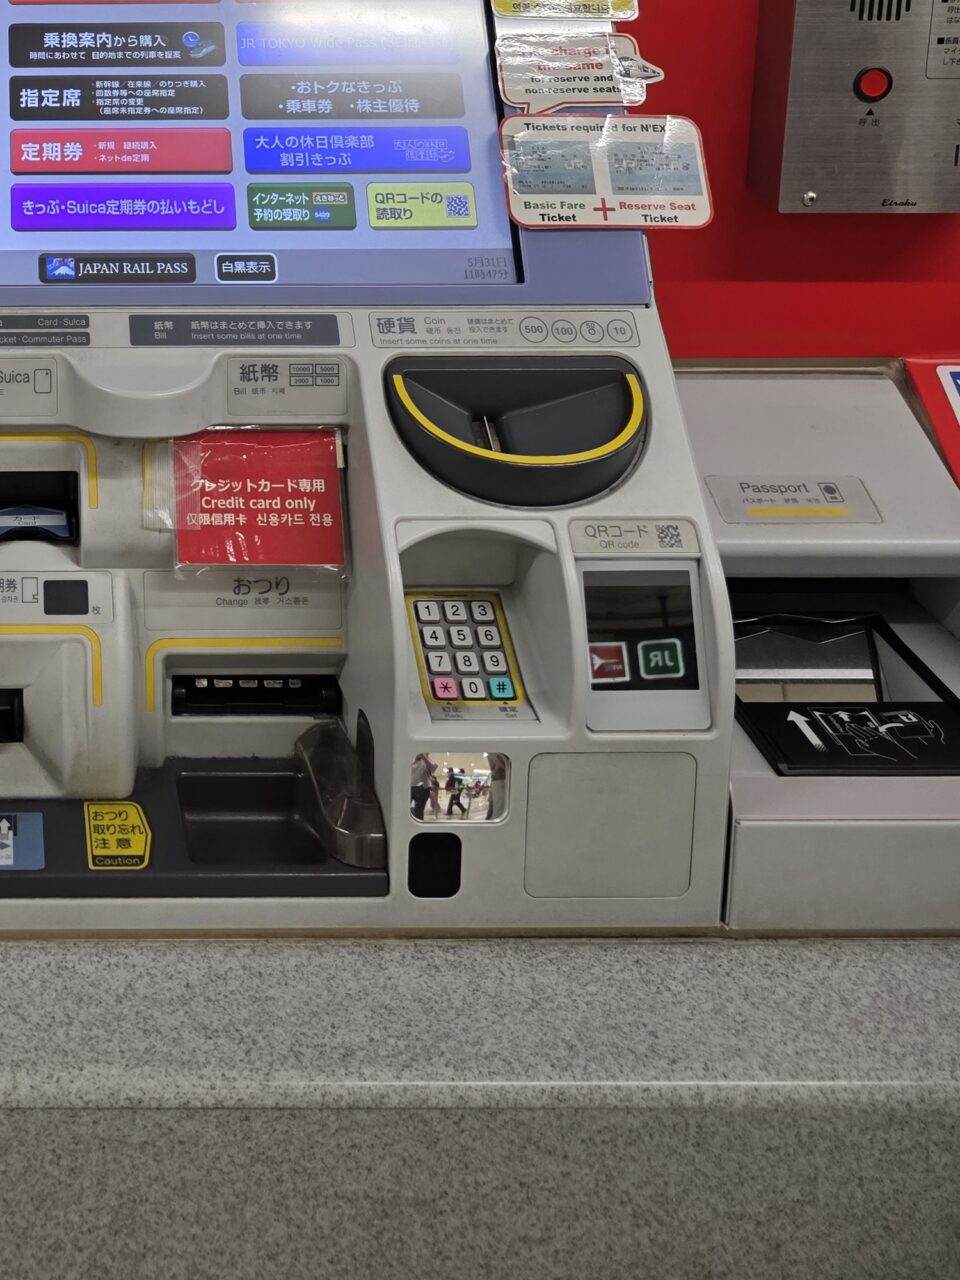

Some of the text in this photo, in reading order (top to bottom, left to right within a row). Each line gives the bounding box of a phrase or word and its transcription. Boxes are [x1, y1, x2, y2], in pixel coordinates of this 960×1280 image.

[43, 32, 167, 49] 乗換案内から購入
[240, 38, 306, 49] JR TOKYO
[593, 74, 614, 82] and
[524, 86, 623, 95] non-reserve seats
[19, 88, 82, 108] 指定席
[524, 122, 567, 132] Tickets
[621, 123, 638, 132] for
[640, 123, 666, 133] N'EX
[20, 142, 83, 161] 定期券
[279, 153, 352, 167] 割引きっぷ
[252, 192, 310, 205] インターネット
[374, 192, 443, 205] QRコードの
[523, 200, 586, 210] Basic Fare
[619, 201, 696, 211] Reserve Seat
[253, 208, 310, 221] 予約の受取り
[376, 208, 413, 221] 読取り
[539, 213, 577, 222] Ticket
[642, 214, 679, 223] Ticket
[78, 262, 188, 276] JAPAN RAIL PASS
[222, 261, 272, 273] 白黒表示
[154, 321, 174, 331] 紙幣
[376, 317, 416, 335] 硬貨
[423, 316, 446, 325] Coin
[154, 331, 167, 340] Bill
[191, 332, 302, 340] Insert some bills at one time
[524, 325, 626, 335] 500 100 10
[66, 334, 87, 344] Pass
[380, 337, 498, 345] Insert some coins at one time
[239, 363, 279, 383] 紙幣
[234, 387, 247, 395] Bill
[739, 482, 809, 495] Passport
[201, 496, 316, 511] Credit card only
[256, 513, 305, 527] 신용카드
[309, 513, 333, 527] 전용
[584, 524, 649, 539] QRコード
[599, 540, 640, 549] QR code
[232, 576, 290, 596] おつり
[215, 597, 249, 607] Change
[92, 605, 101, 615] 枚
[451, 605, 460, 616] 2
[478, 605, 488, 616] 3
[430, 629, 494, 641] 4 5 6
[434, 655, 500, 667] 7 8 9
[468, 681, 478, 694] 0
[92, 809, 129, 821] おつり
[93, 823, 144, 835] 取り忘れ
[94, 837, 132, 850] 注意
[95, 855, 141, 866] Caution
